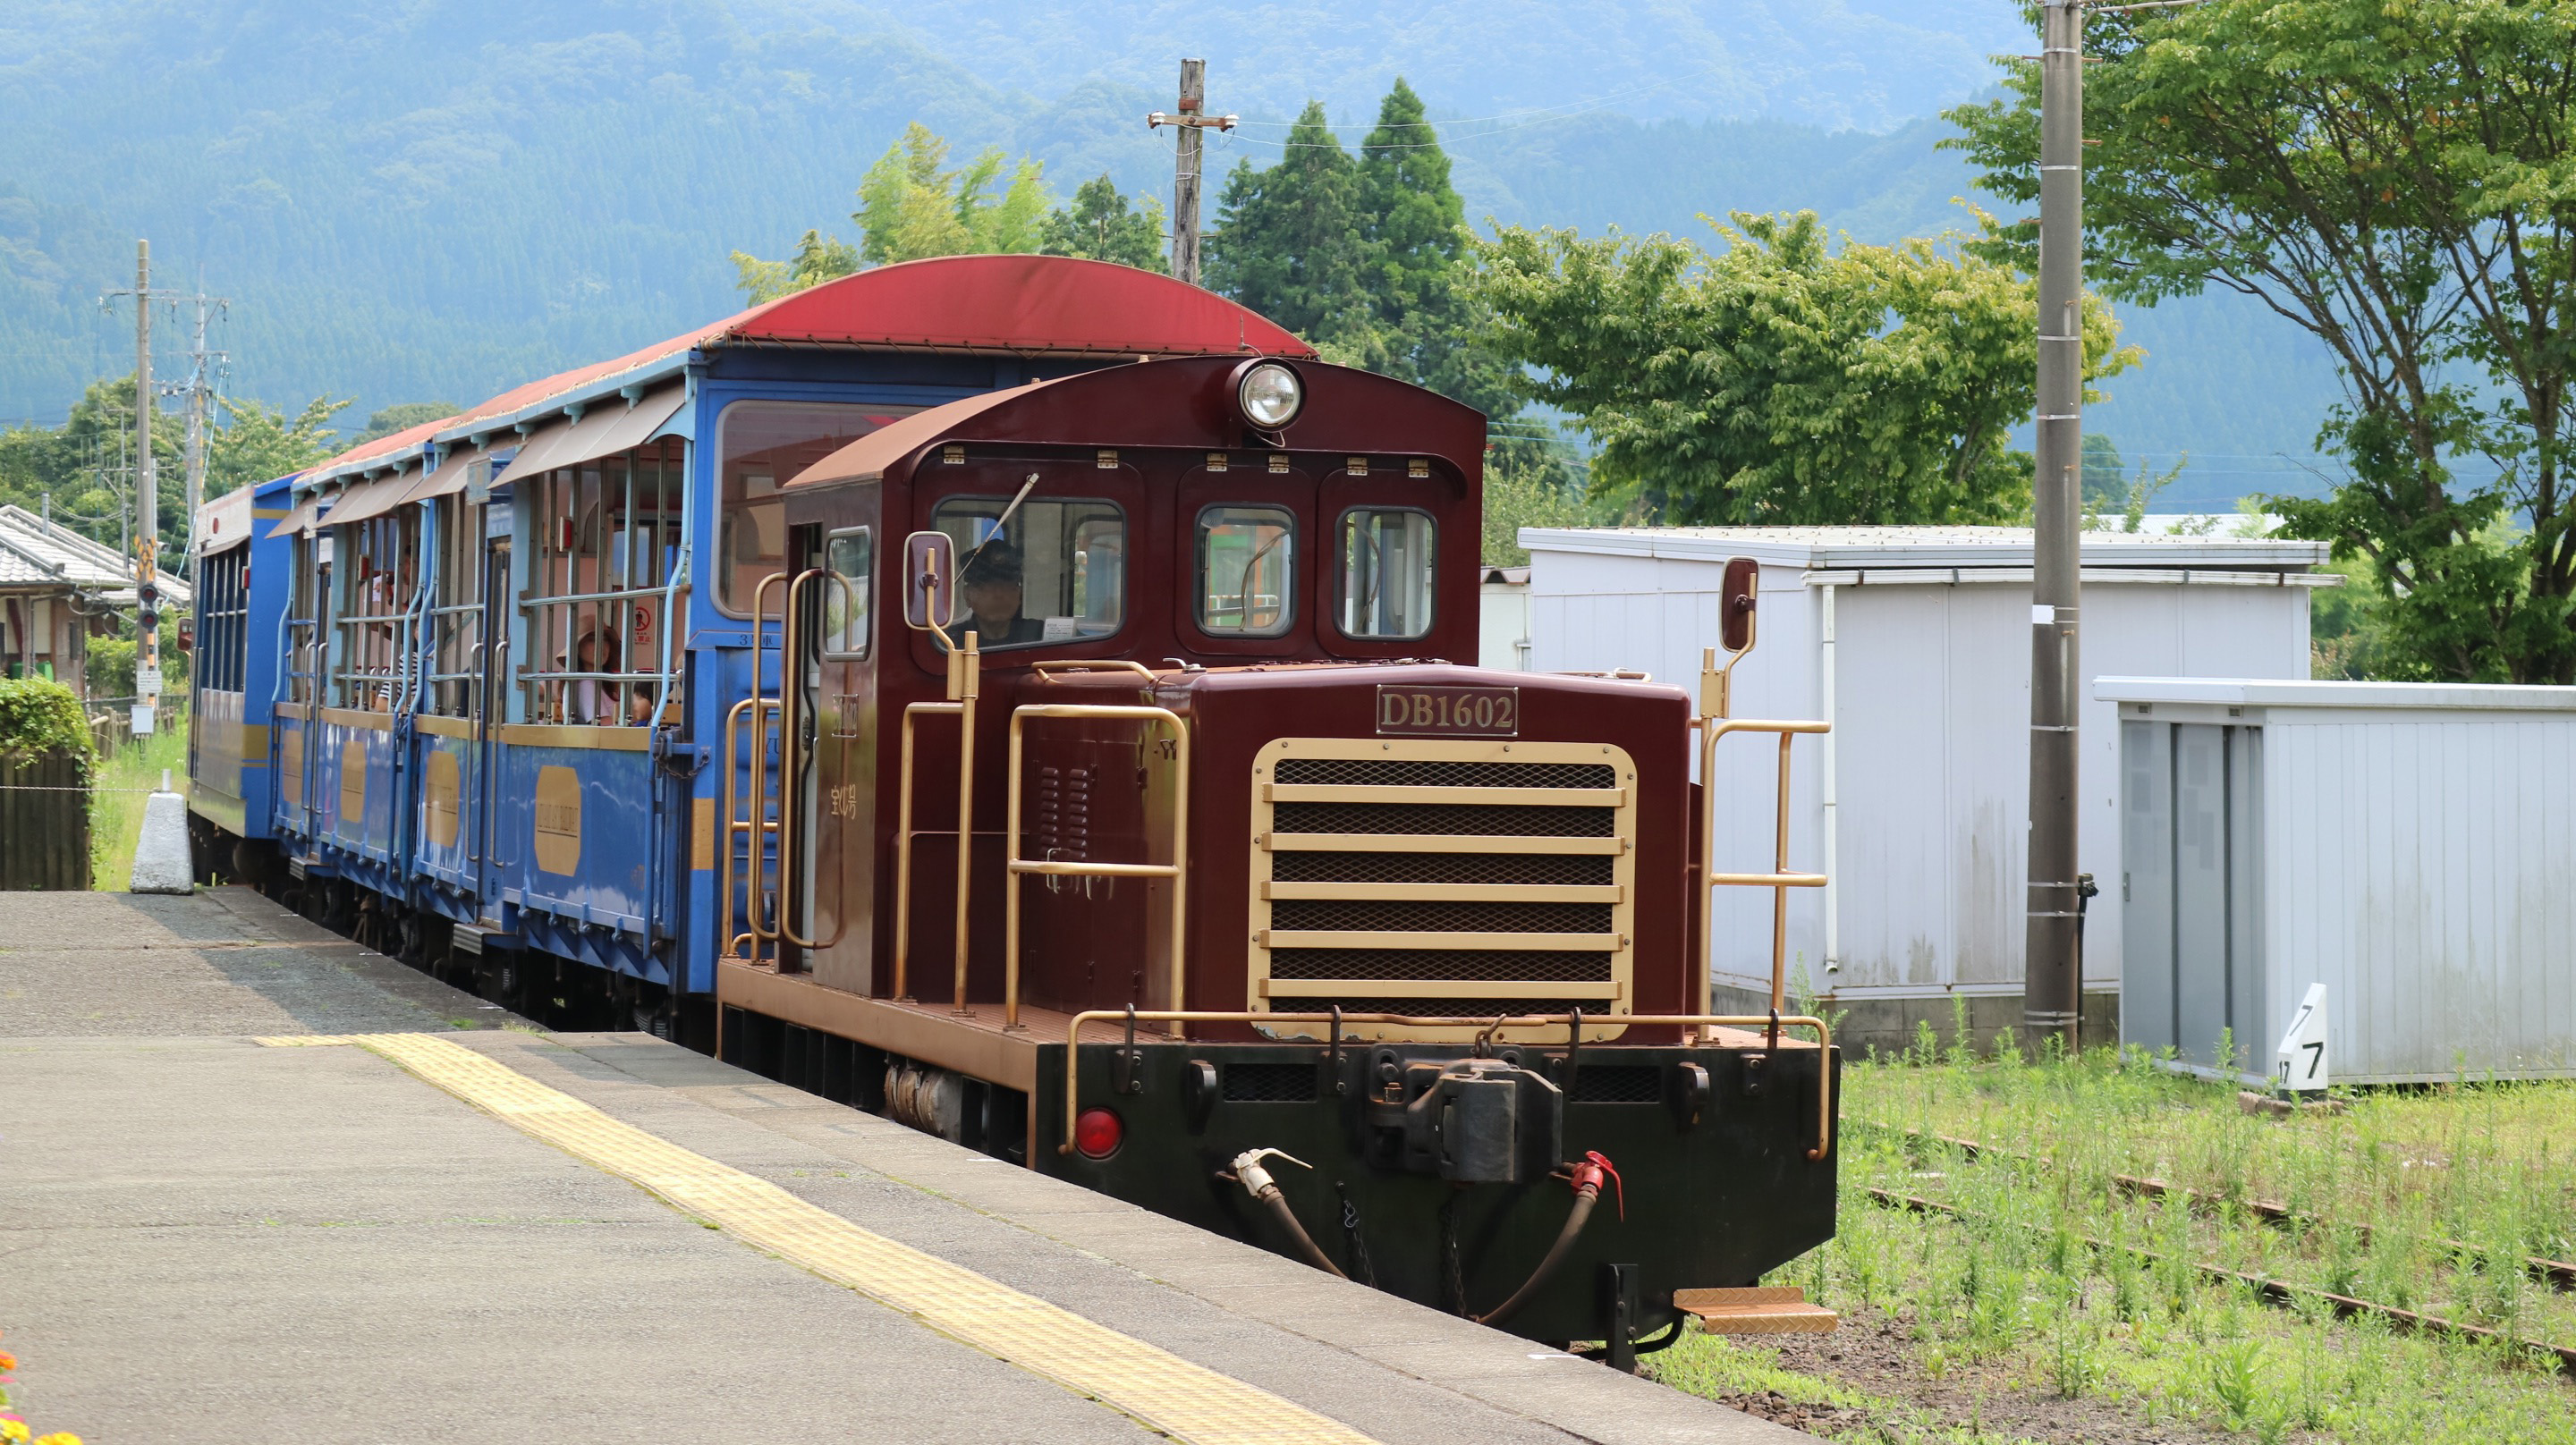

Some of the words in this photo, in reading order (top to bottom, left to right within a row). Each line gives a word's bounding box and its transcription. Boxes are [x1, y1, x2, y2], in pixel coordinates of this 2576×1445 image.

[740, 634, 773, 646] 3車
[1381, 693, 1513, 728] DB1602
[2289, 1005, 2314, 1036] 7
[2279, 1061, 2290, 1084] 17
[2302, 1042, 2324, 1079] 7
